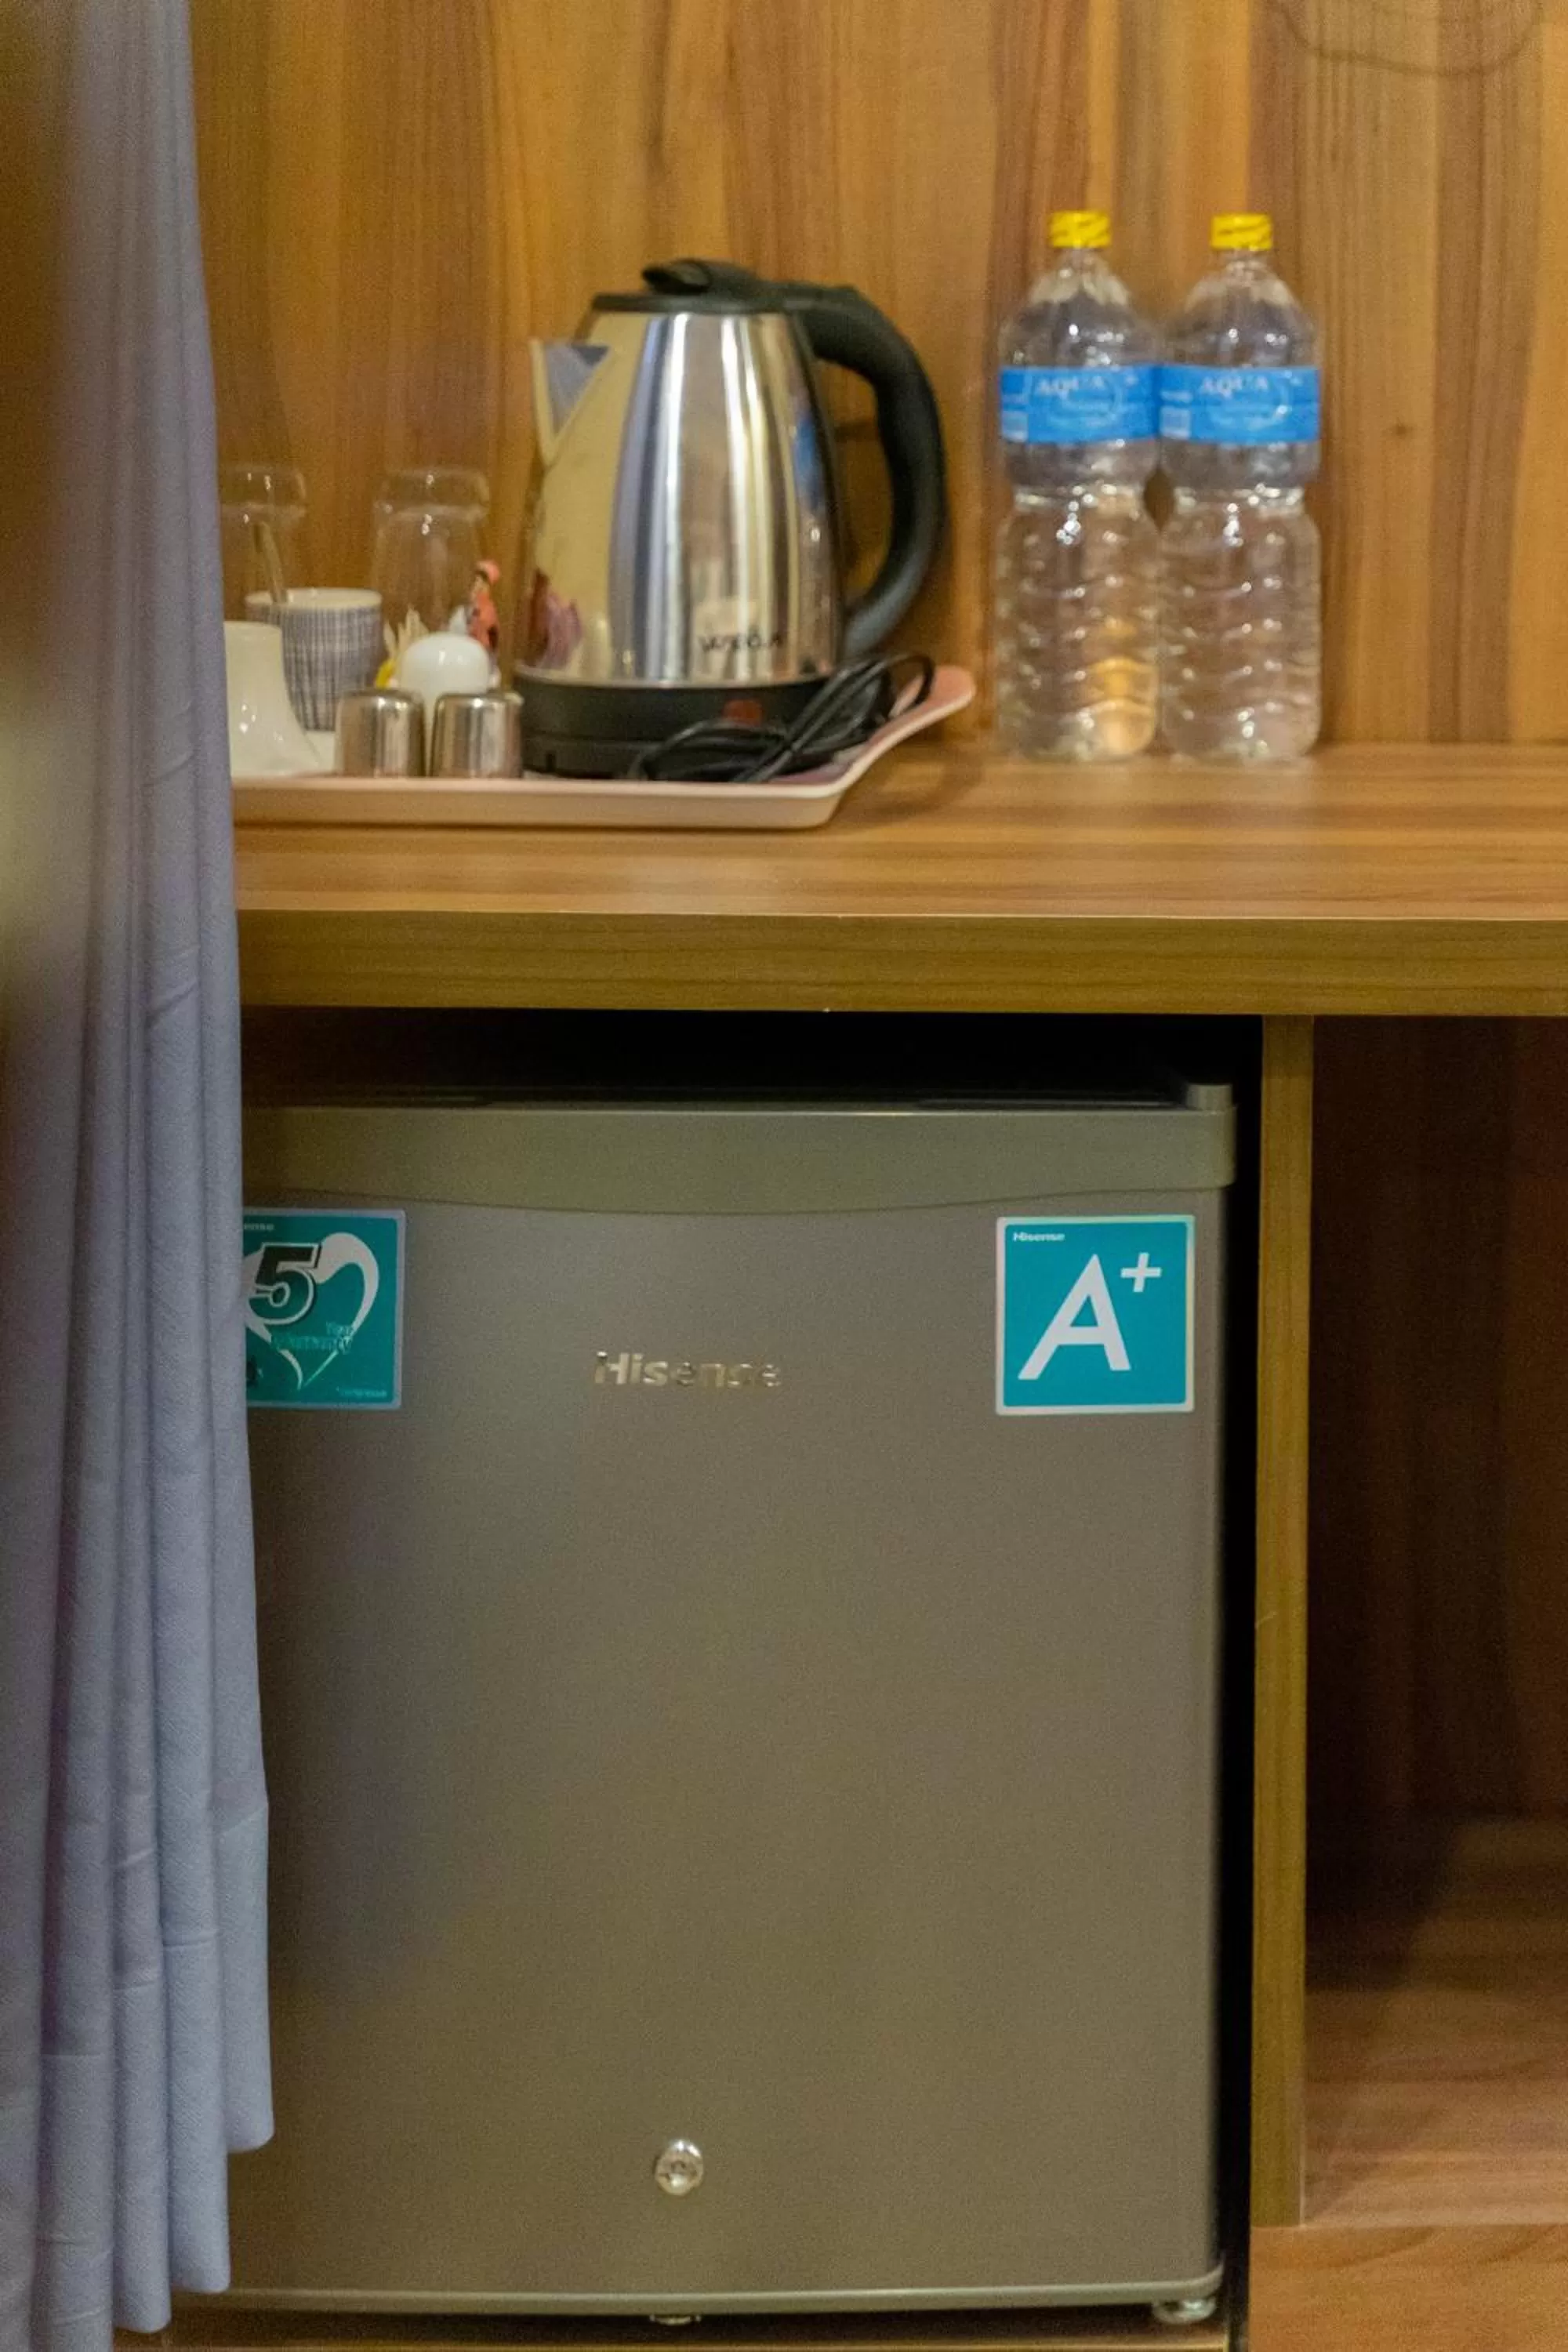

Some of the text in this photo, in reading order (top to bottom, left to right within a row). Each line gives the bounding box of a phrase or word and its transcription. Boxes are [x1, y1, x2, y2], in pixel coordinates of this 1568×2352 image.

[1200, 375, 1269, 399] AQUA
[248, 1241, 322, 1326] 5
[1018, 1251, 1163, 1381] A+
